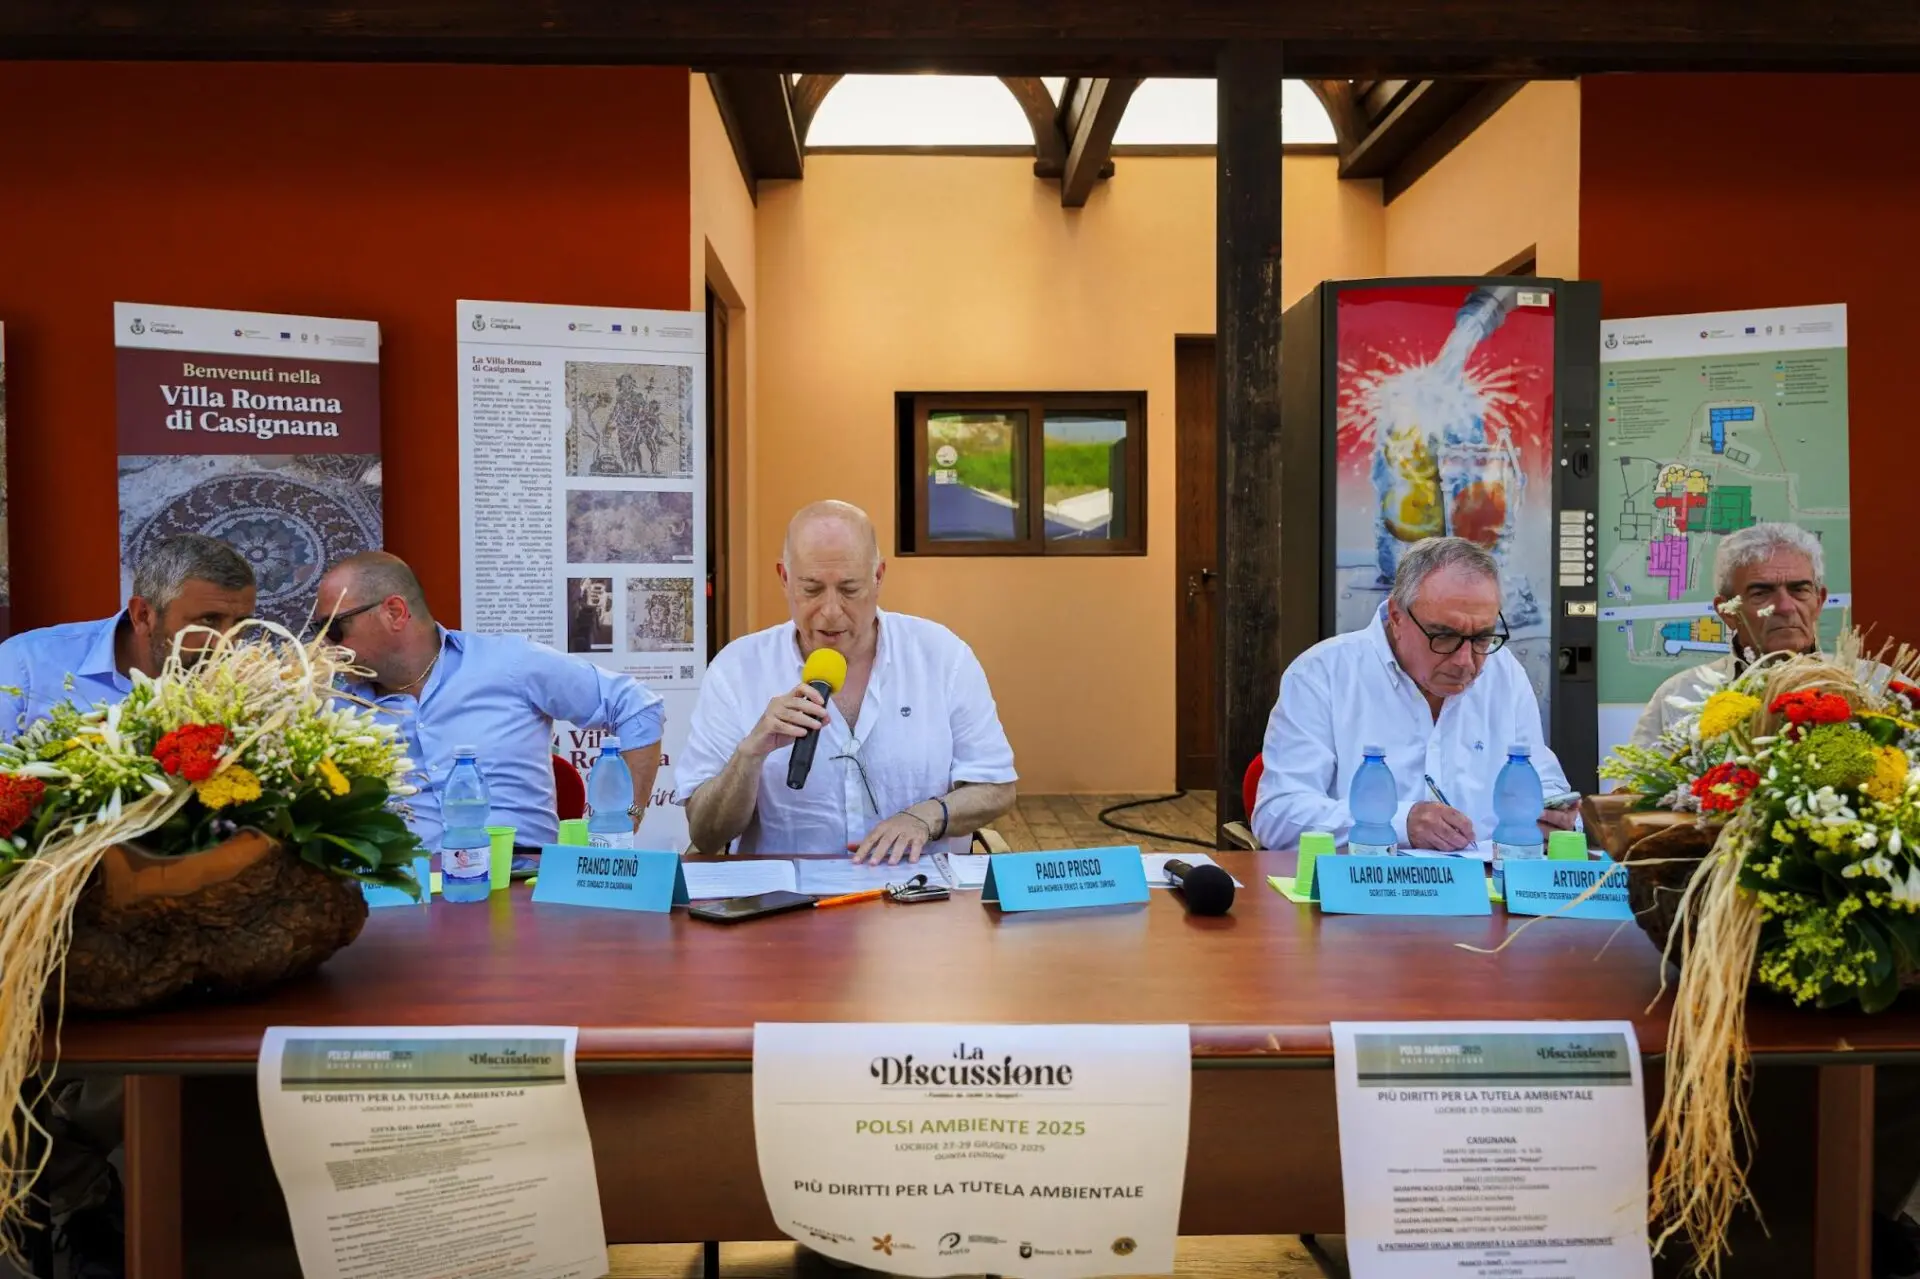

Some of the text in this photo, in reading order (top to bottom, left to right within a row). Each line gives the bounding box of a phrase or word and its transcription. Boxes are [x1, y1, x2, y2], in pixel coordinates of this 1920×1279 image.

[472, 356, 541, 366] La Villa Romana
[482, 365, 525, 374] Casignana
[183, 363, 321, 384] Benvenuti nella
[160, 385, 342, 414] Villa Romana
[166, 409, 339, 440] di Casignana
[577, 854, 638, 877] FRANCO CRINÒ
[1036, 859, 1101, 880] PAOLO PRISCO
[1349, 866, 1454, 884] ILARIO AMMENDOLIA
[1553, 870, 1595, 887] ARTURO
[1369, 889, 1397, 897] SCRITTORE
[1402, 889, 1438, 897] EDITORIALISTA
[1515, 890, 1548, 900] PRESIDENTE
[469, 1052, 552, 1065] Discussione
[953, 1042, 984, 1060] La
[1537, 1047, 1617, 1060] Discussione
[870, 1054, 1073, 1085] Discussione
[325, 1093, 365, 1102] DIRITTI
[368, 1093, 389, 1102] PER
[391, 1092, 405, 1101] LA
[409, 1092, 449, 1101] TUTELA
[453, 1090, 525, 1100] AMBIENTALE
[1378, 1090, 1594, 1101] PIÙ DIRITTI PER LA TUTELA AMBIENTALE
[856, 1118, 1086, 1136] POLSI AMBIENTE 2025
[895, 1143, 939, 1151] LOCRIDE
[973, 1141, 1018, 1151] GIUGNO
[1020, 1143, 1046, 1152] 2025
[1466, 1136, 1517, 1145] CASIGNANA
[794, 1178, 1144, 1199] PIÙ DIRITTI PER LA TUTELA AMBIENTALE
